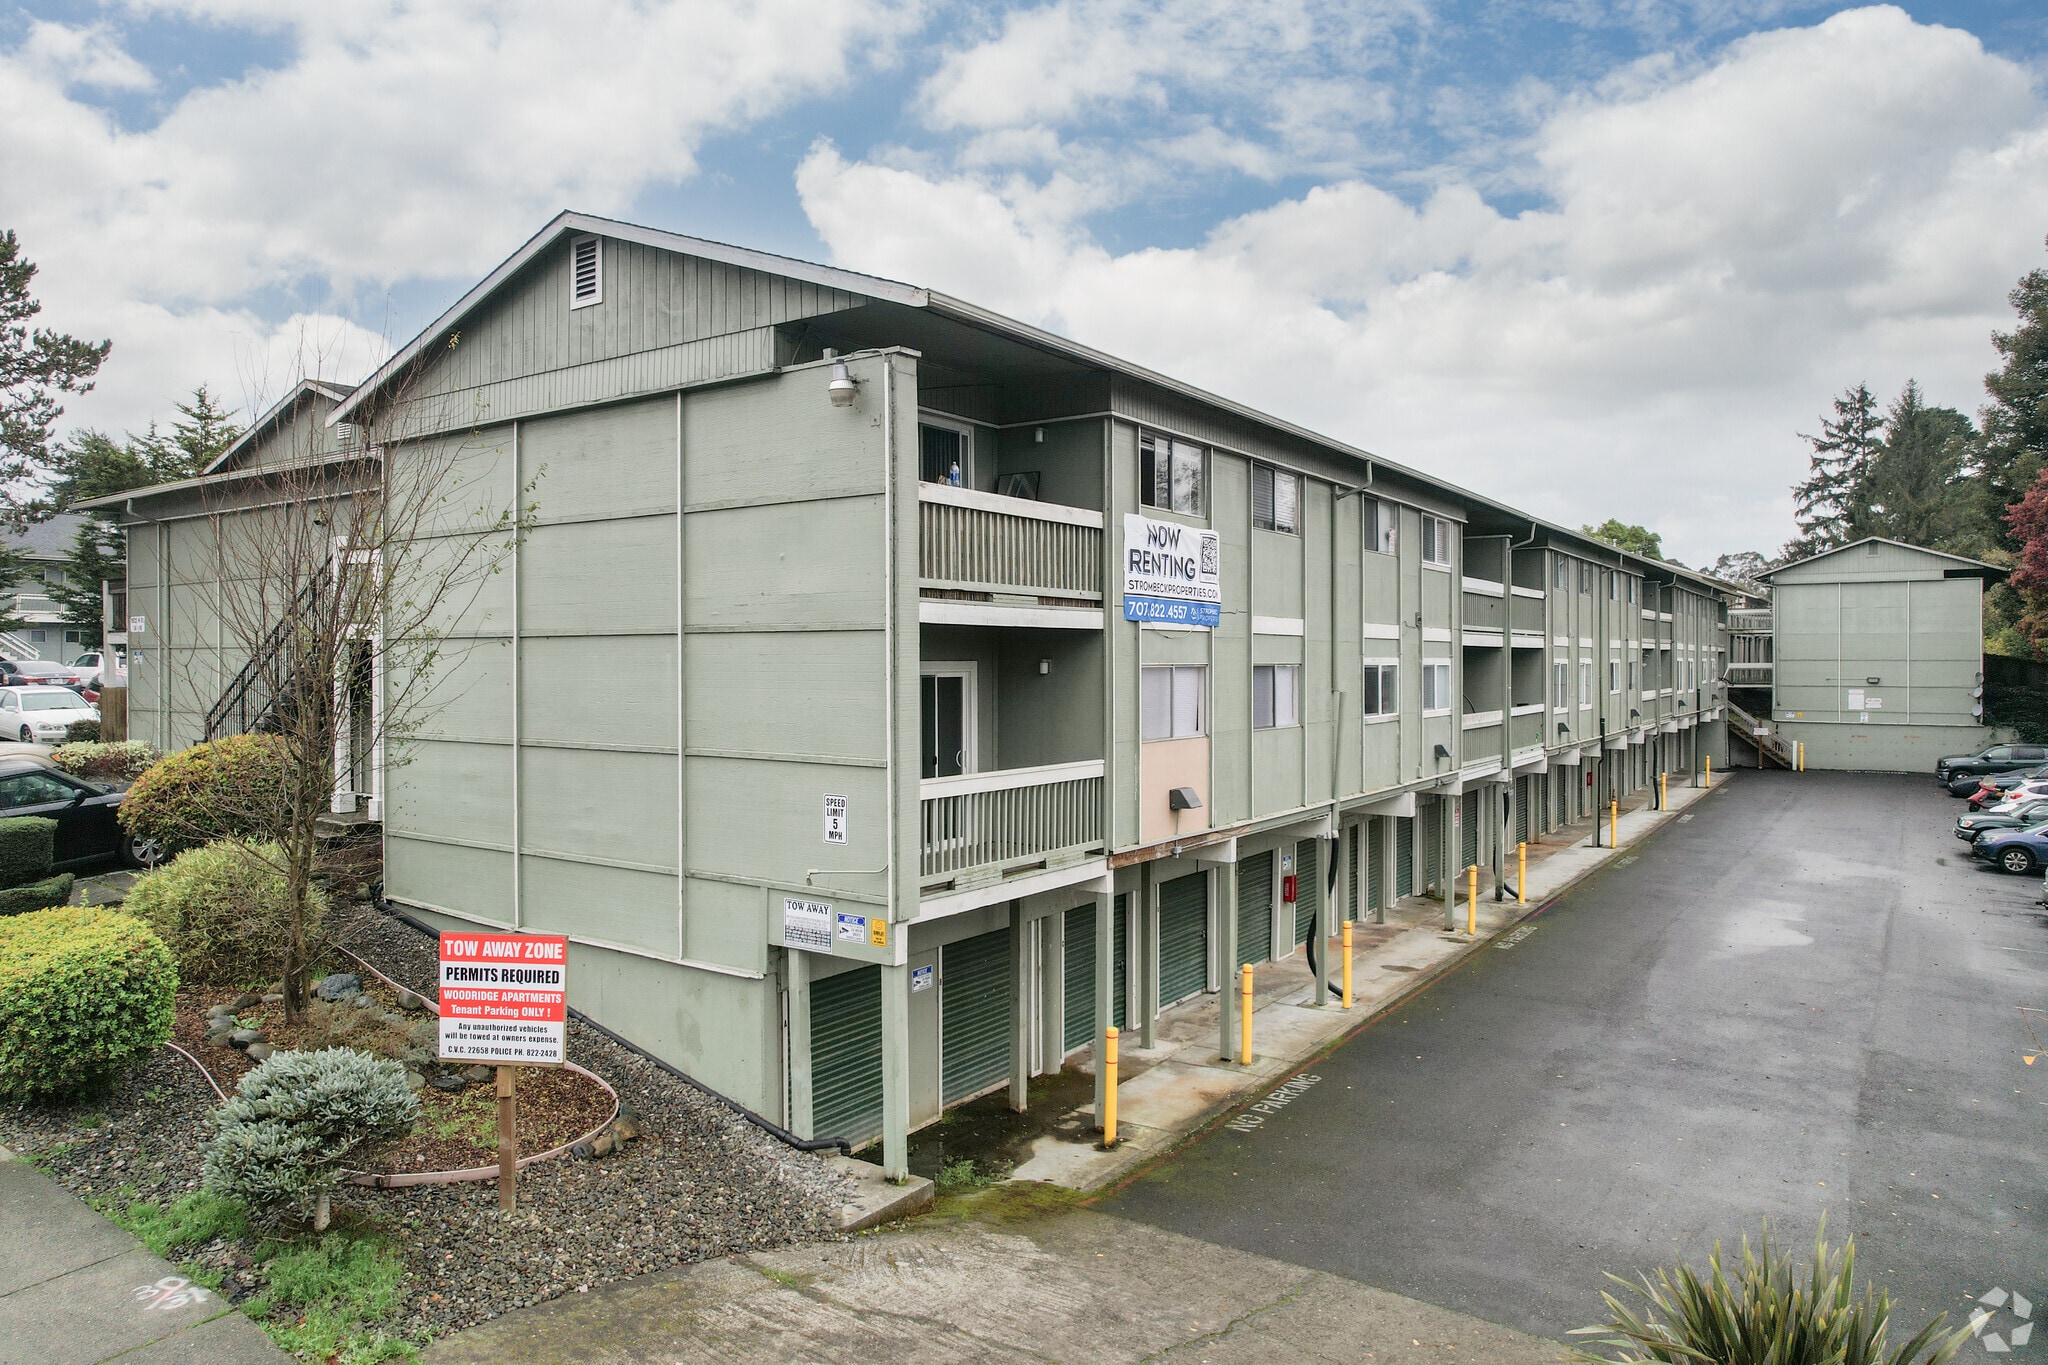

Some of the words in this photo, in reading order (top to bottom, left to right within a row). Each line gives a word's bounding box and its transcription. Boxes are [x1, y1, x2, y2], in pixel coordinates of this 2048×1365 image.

[1147, 524, 1181, 549] NOW
[1129, 549, 1196, 580] RENTING
[1128, 601, 1188, 619] 707.822.4557
[826, 797, 846, 808] SPEED
[826, 807, 844, 818] LIMIT
[832, 818, 838, 830] 5
[828, 830, 843, 841] MPH
[787, 901, 805, 911] TOW
[807, 904, 829, 915] AWAY
[445, 940, 478, 957] TOW
[482, 941, 521, 958] AWAY
[525, 942, 563, 959] ZONE
[446, 967, 498, 982] PERMITS
[501, 969, 559, 984] REQUIRED
[444, 990, 498, 1001] WOODRIDGE
[501, 992, 562, 1004] APARTMENTS
[451, 1004, 482, 1015] Tenant
[484, 1005, 519, 1018] Parking
[521, 1007, 545, 1017] ONLY
[458, 1022, 471, 1031] Any
[472, 1024, 517, 1032] unauthorized
[519, 1025, 548, 1033] vehicles
[445, 1032, 458, 1040] will
[469, 1033, 491, 1041] towed
[528, 1036, 559, 1044] expense.
[467, 1046, 489, 1054] 22658
[490, 1047, 512, 1055] POLICE
[514, 1048, 525, 1056] PH.
[526, 1048, 558, 1057] 822-2428
[1224, 1113, 1265, 1133] NO
[1250, 1073, 1322, 1114] PARKING
